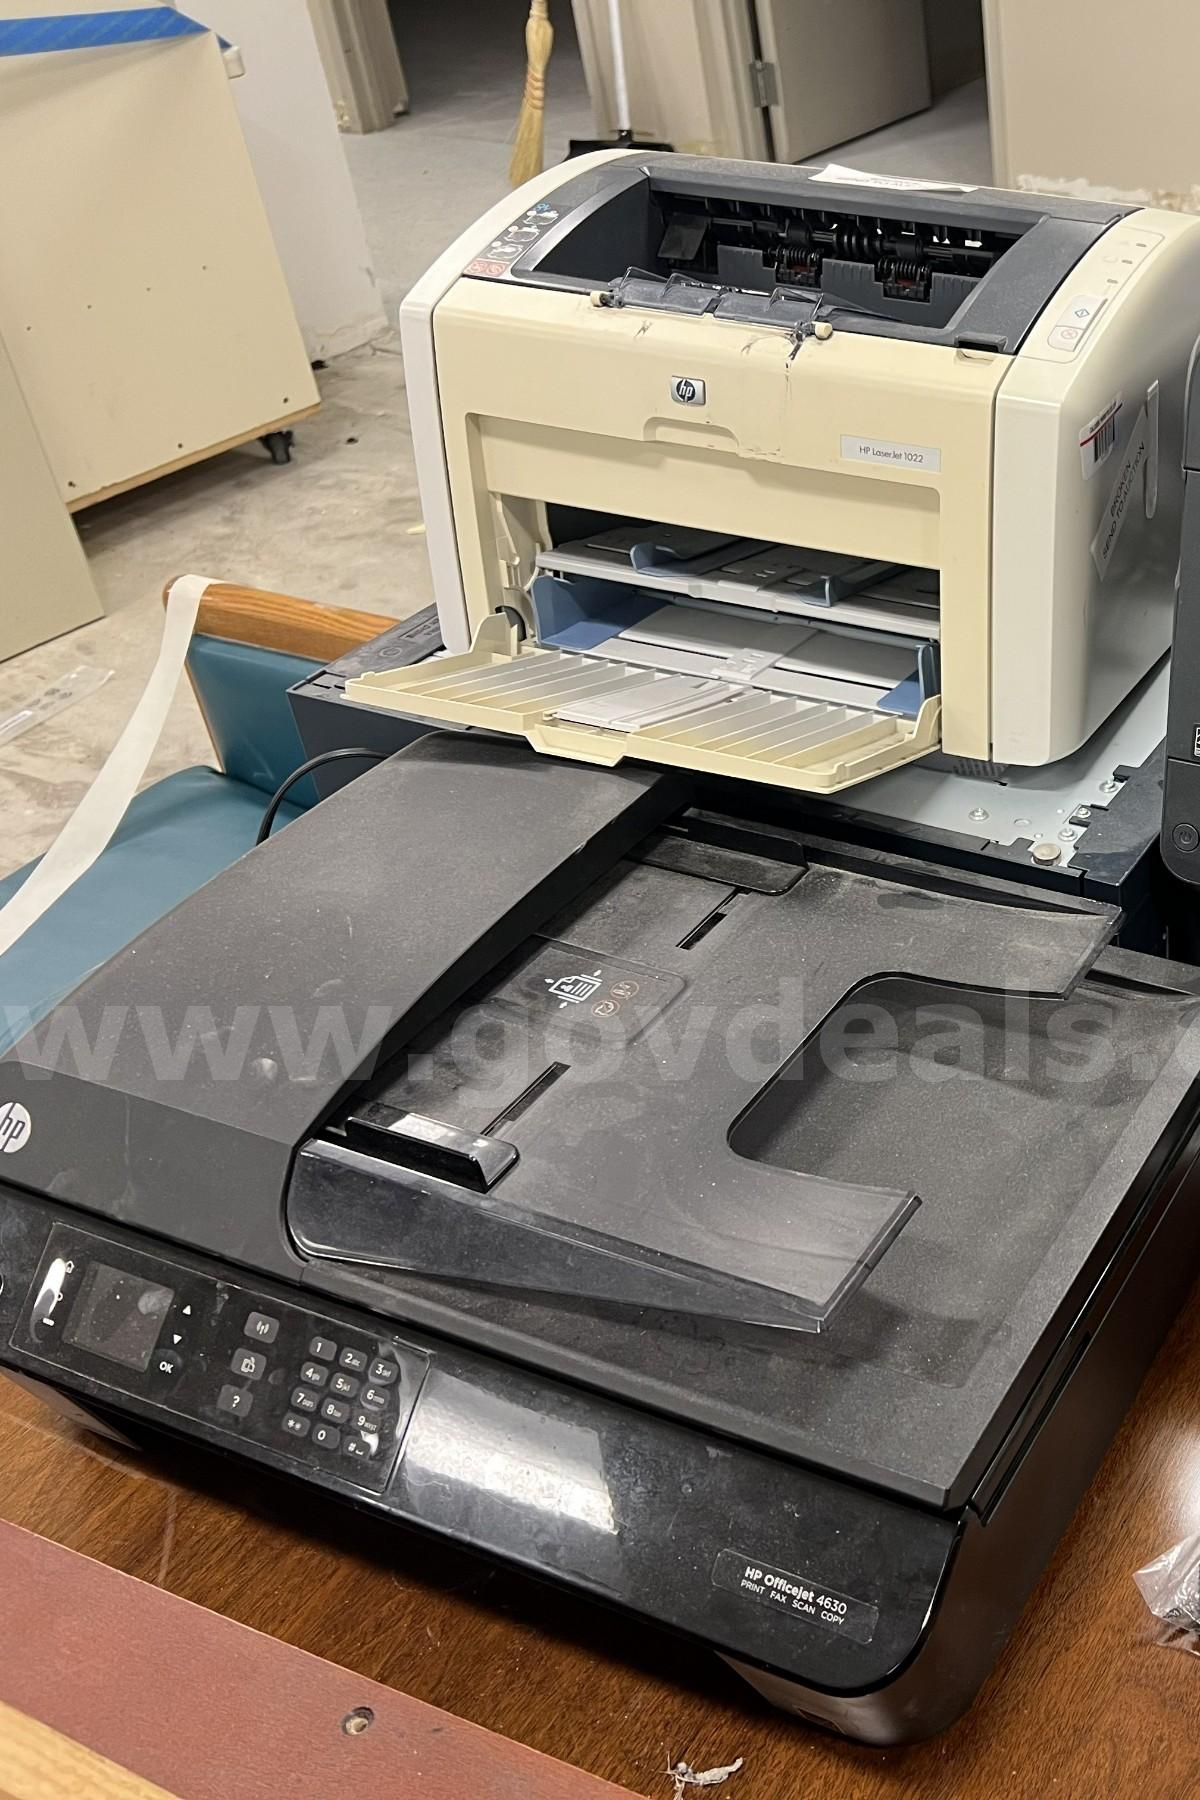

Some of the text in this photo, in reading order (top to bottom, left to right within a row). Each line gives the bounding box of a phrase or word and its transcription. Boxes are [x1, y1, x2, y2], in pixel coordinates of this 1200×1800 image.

[678, 379, 694, 402] hp
[860, 445, 924, 463] HP LaserJet 1022
[1102, 520, 1117, 560] SEND
[0, 1102, 27, 1151] hp
[316, 1342, 322, 1352] 1
[159, 1361, 174, 1374] OK
[318, 1430, 326, 1440] 0
[740, 1579, 845, 1625] PRINT FAX SCAN COPY
[745, 1566, 847, 1615] HP Officejet 4630
